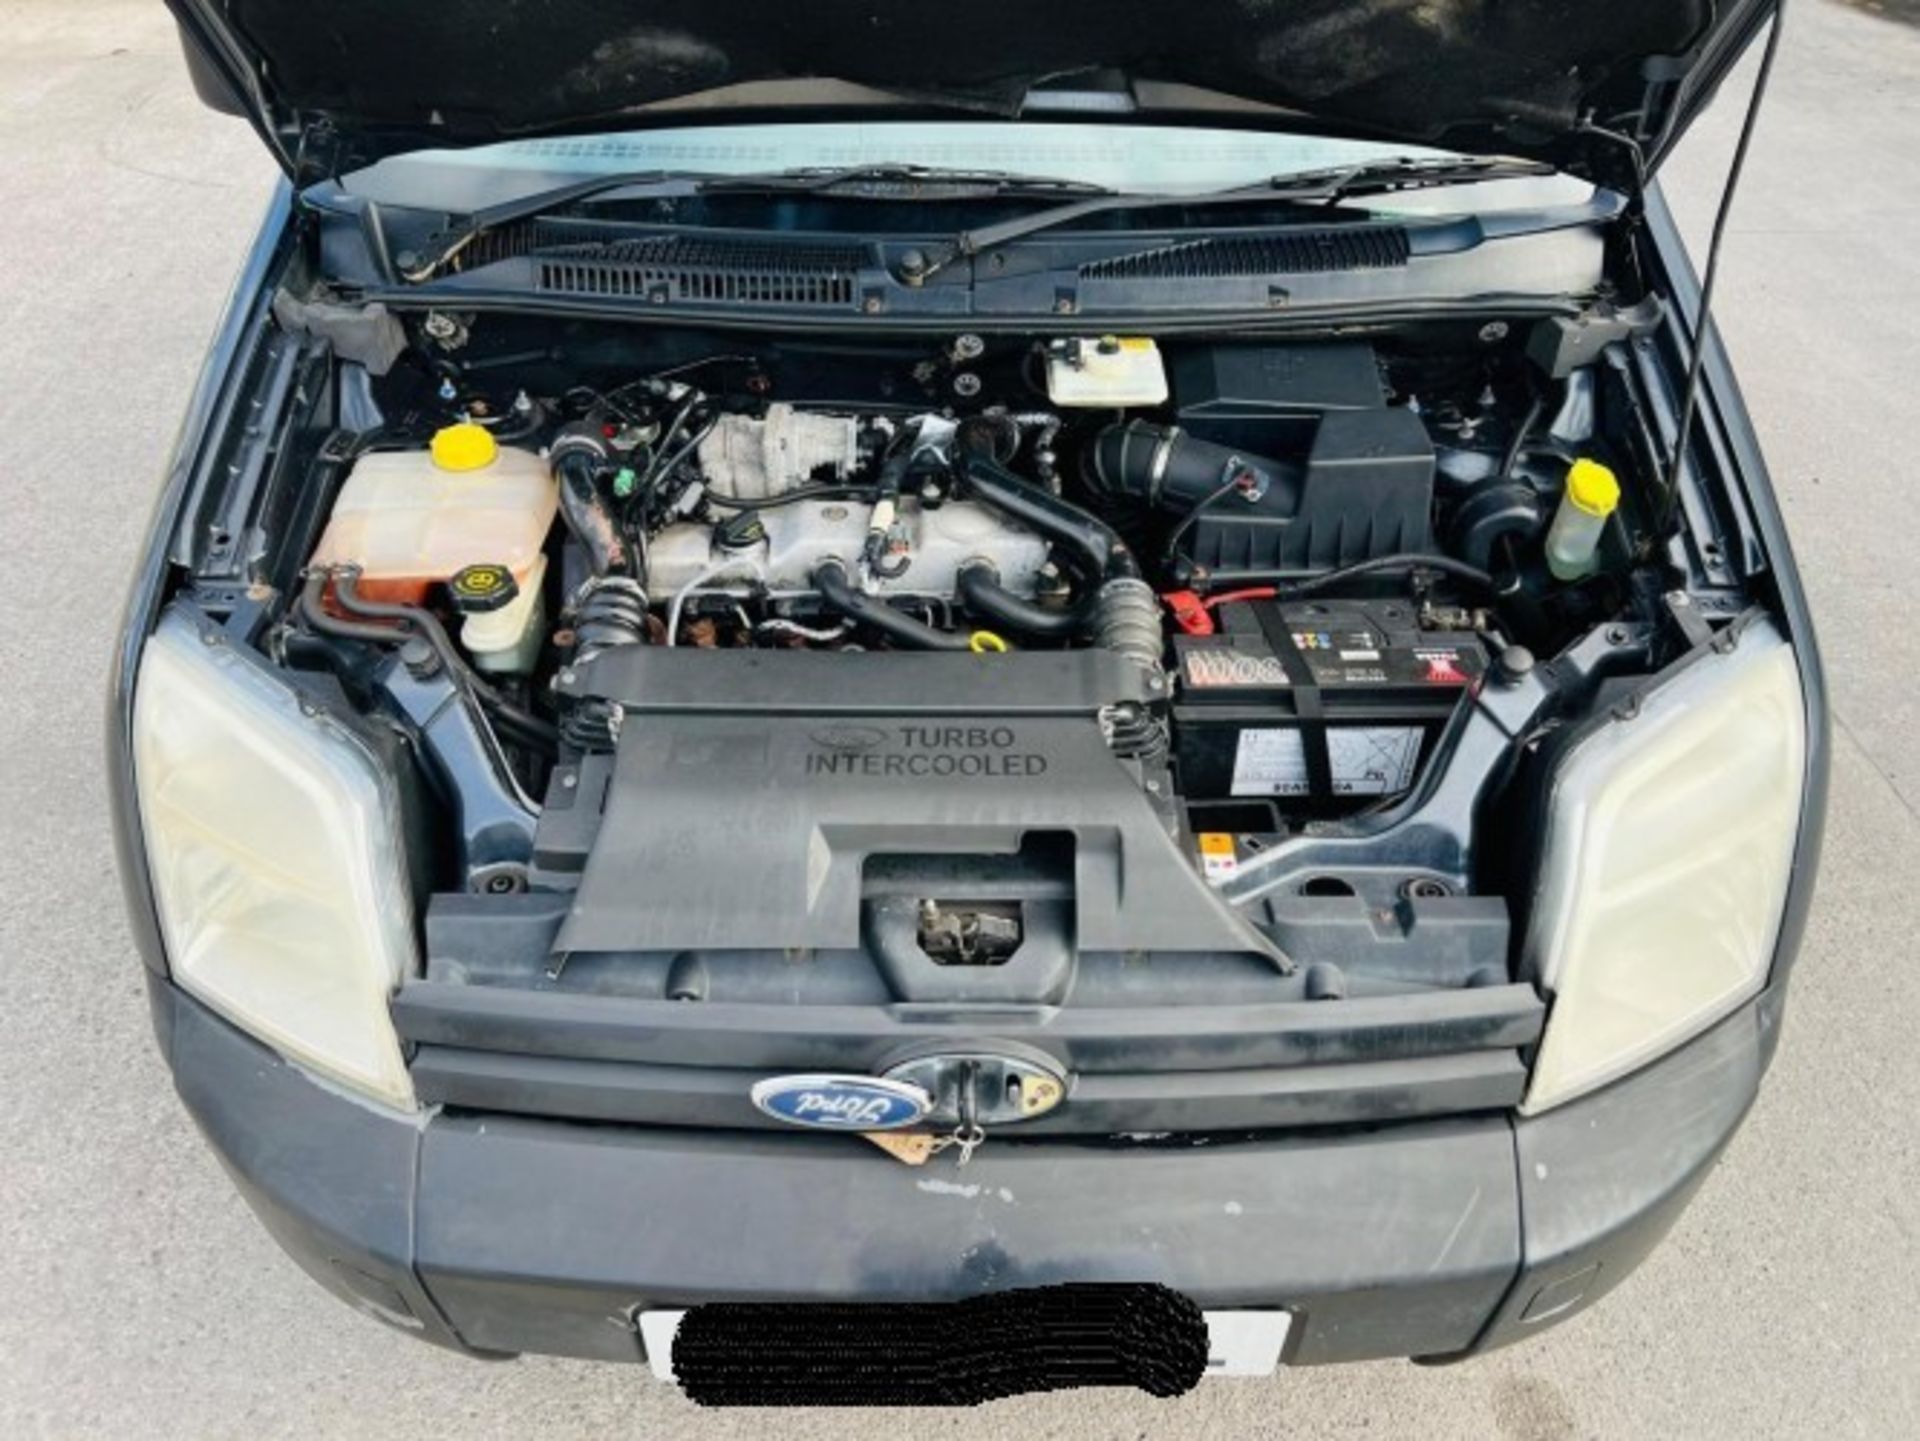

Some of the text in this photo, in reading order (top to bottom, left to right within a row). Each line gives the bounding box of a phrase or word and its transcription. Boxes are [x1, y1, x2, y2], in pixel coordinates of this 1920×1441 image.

[900, 727, 1015, 748] TURBO
[805, 754, 1048, 776] INTERCOOLED
[794, 1091, 892, 1123] Ford
